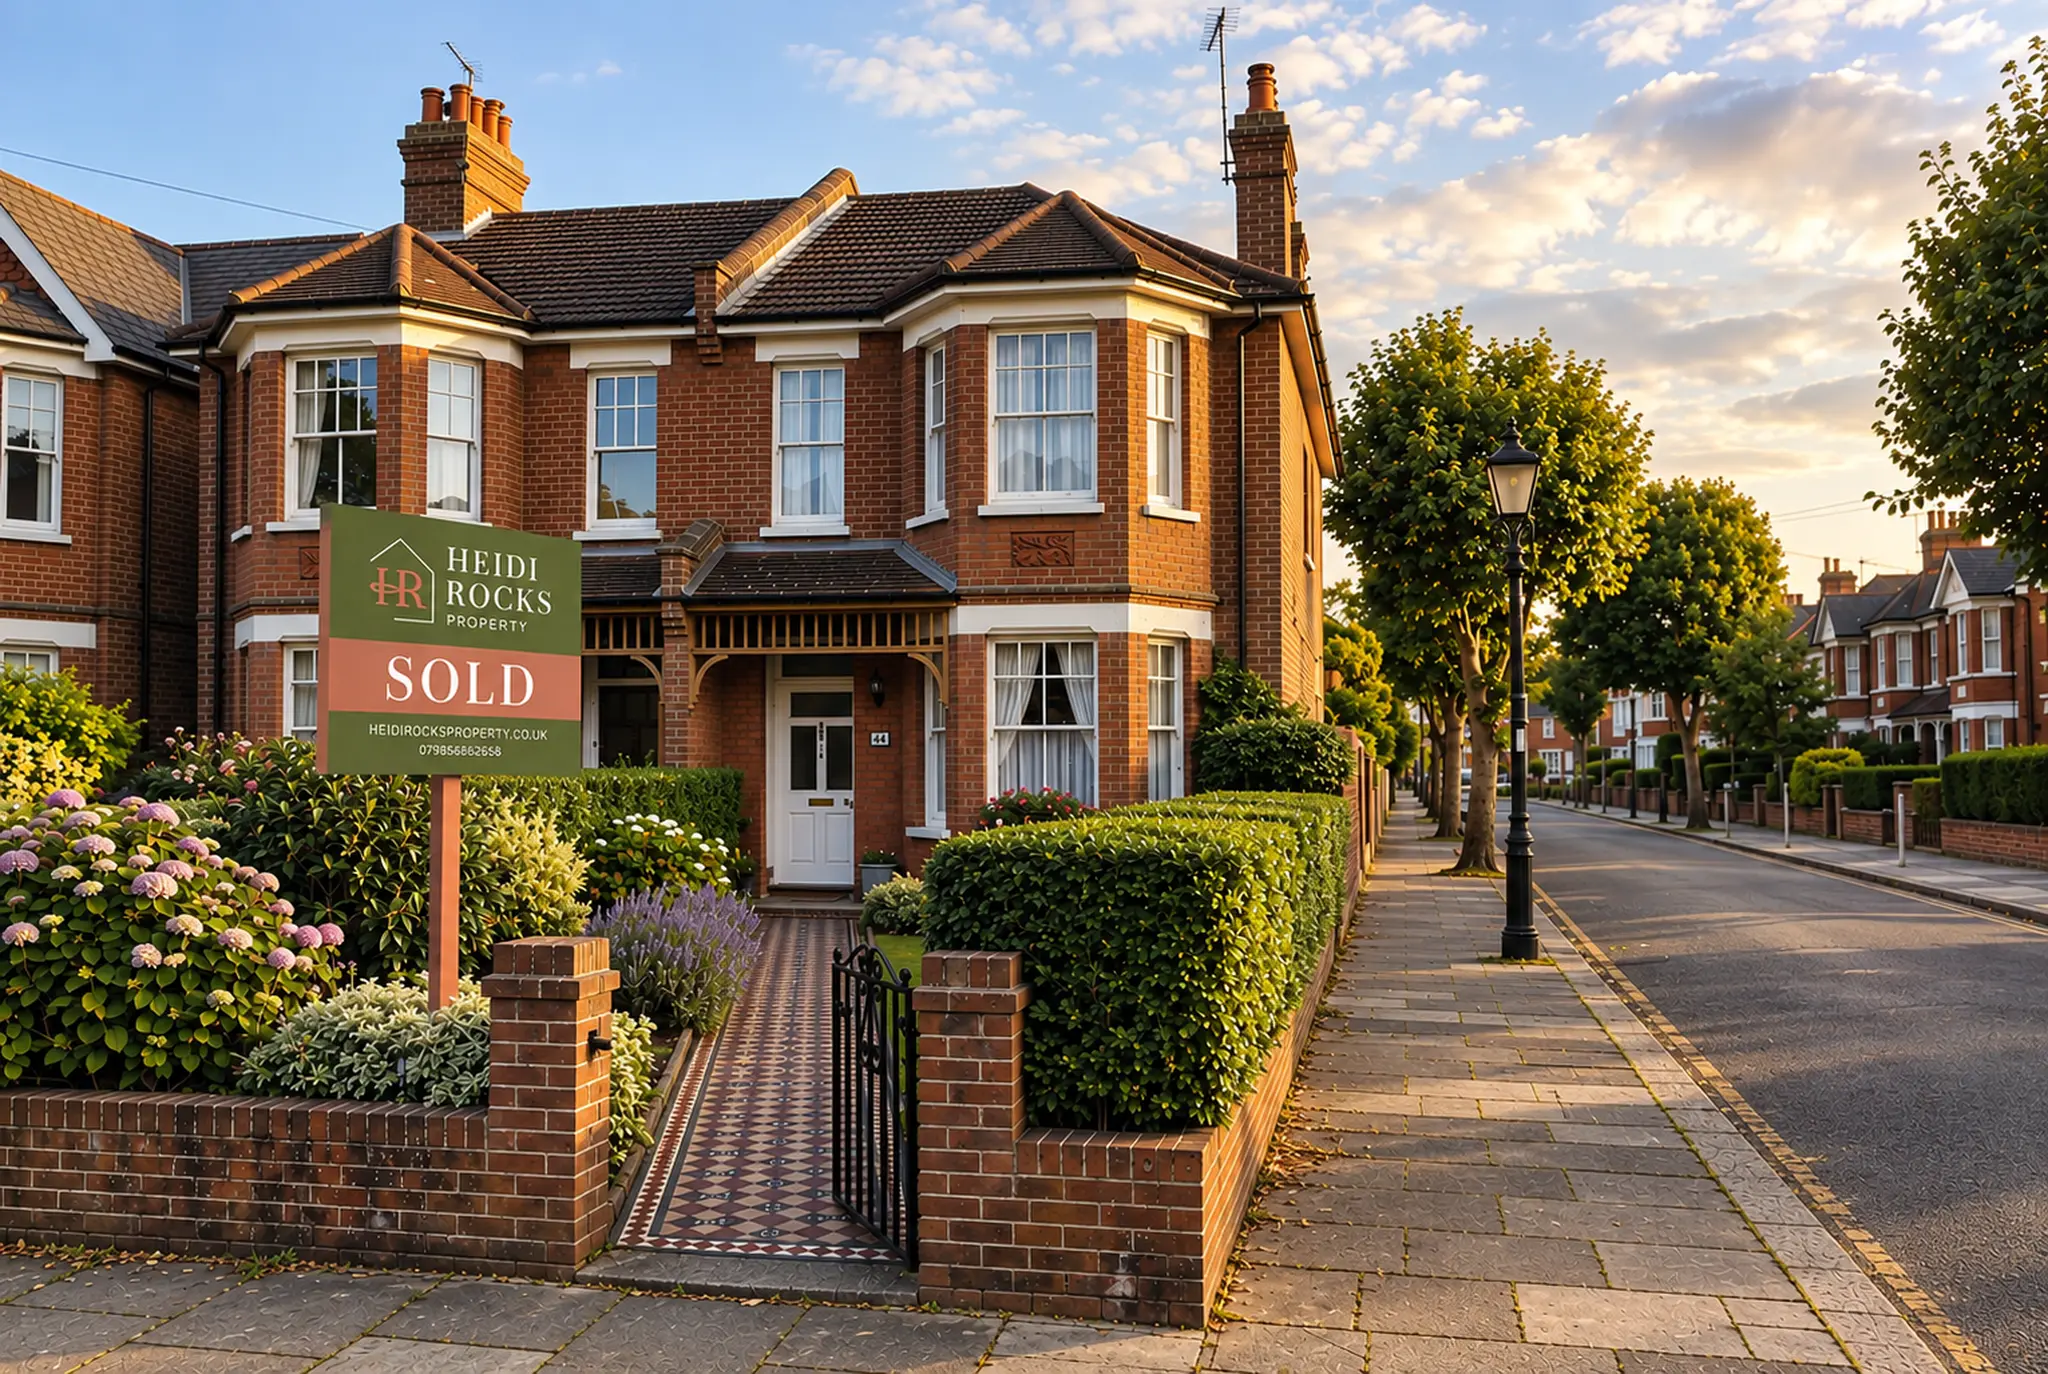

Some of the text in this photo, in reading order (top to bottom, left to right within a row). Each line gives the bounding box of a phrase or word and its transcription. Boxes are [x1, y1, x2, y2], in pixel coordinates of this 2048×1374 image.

[447, 546, 538, 581] HEIDI
[446, 580, 552, 615] ROCKS
[446, 614, 528, 633] PROPERTY
[386, 655, 534, 706] SOLD
[369, 724, 548, 740] HEIDIROCKSPROPERTY.CO.UK
